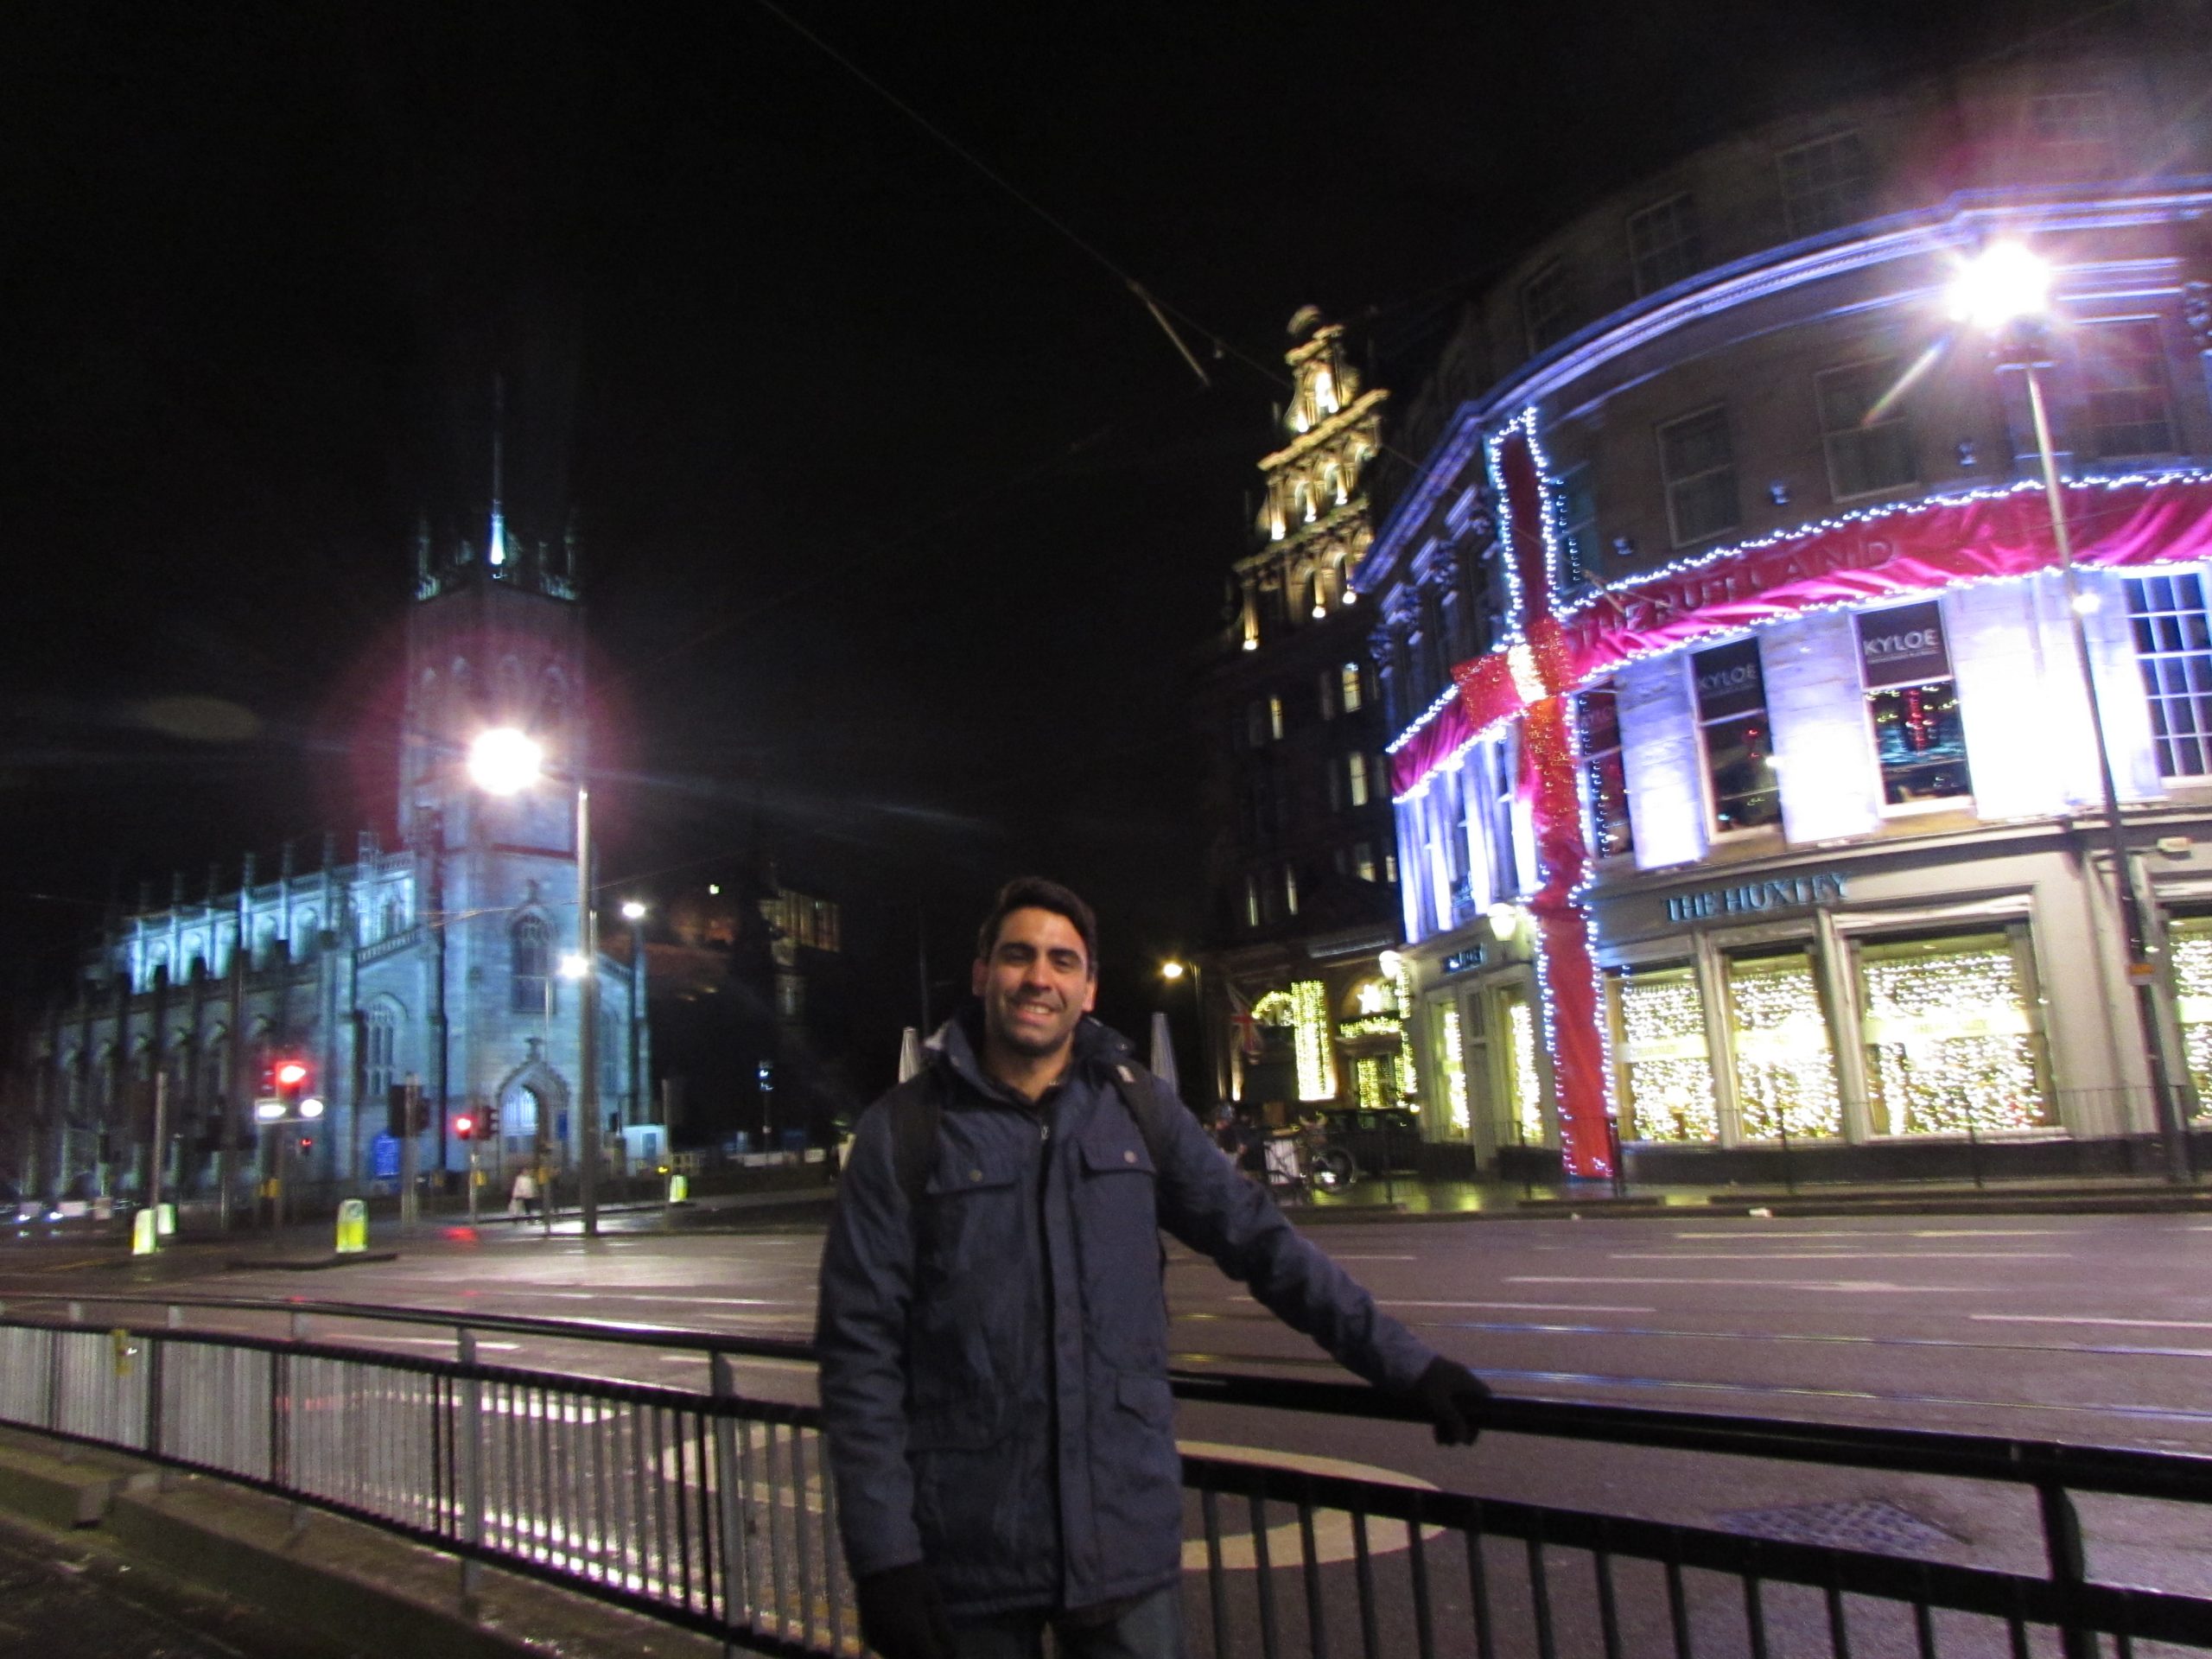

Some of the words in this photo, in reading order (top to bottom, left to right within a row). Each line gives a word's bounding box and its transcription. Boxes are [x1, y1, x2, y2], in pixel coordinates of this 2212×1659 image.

[1863, 628, 1938, 656] KYLOE
[1698, 664, 1757, 690] KYLOE
[1580, 704, 1614, 728] KYLO
[1664, 890, 1723, 922] THE
[1725, 871, 1853, 912] HUXLEY
